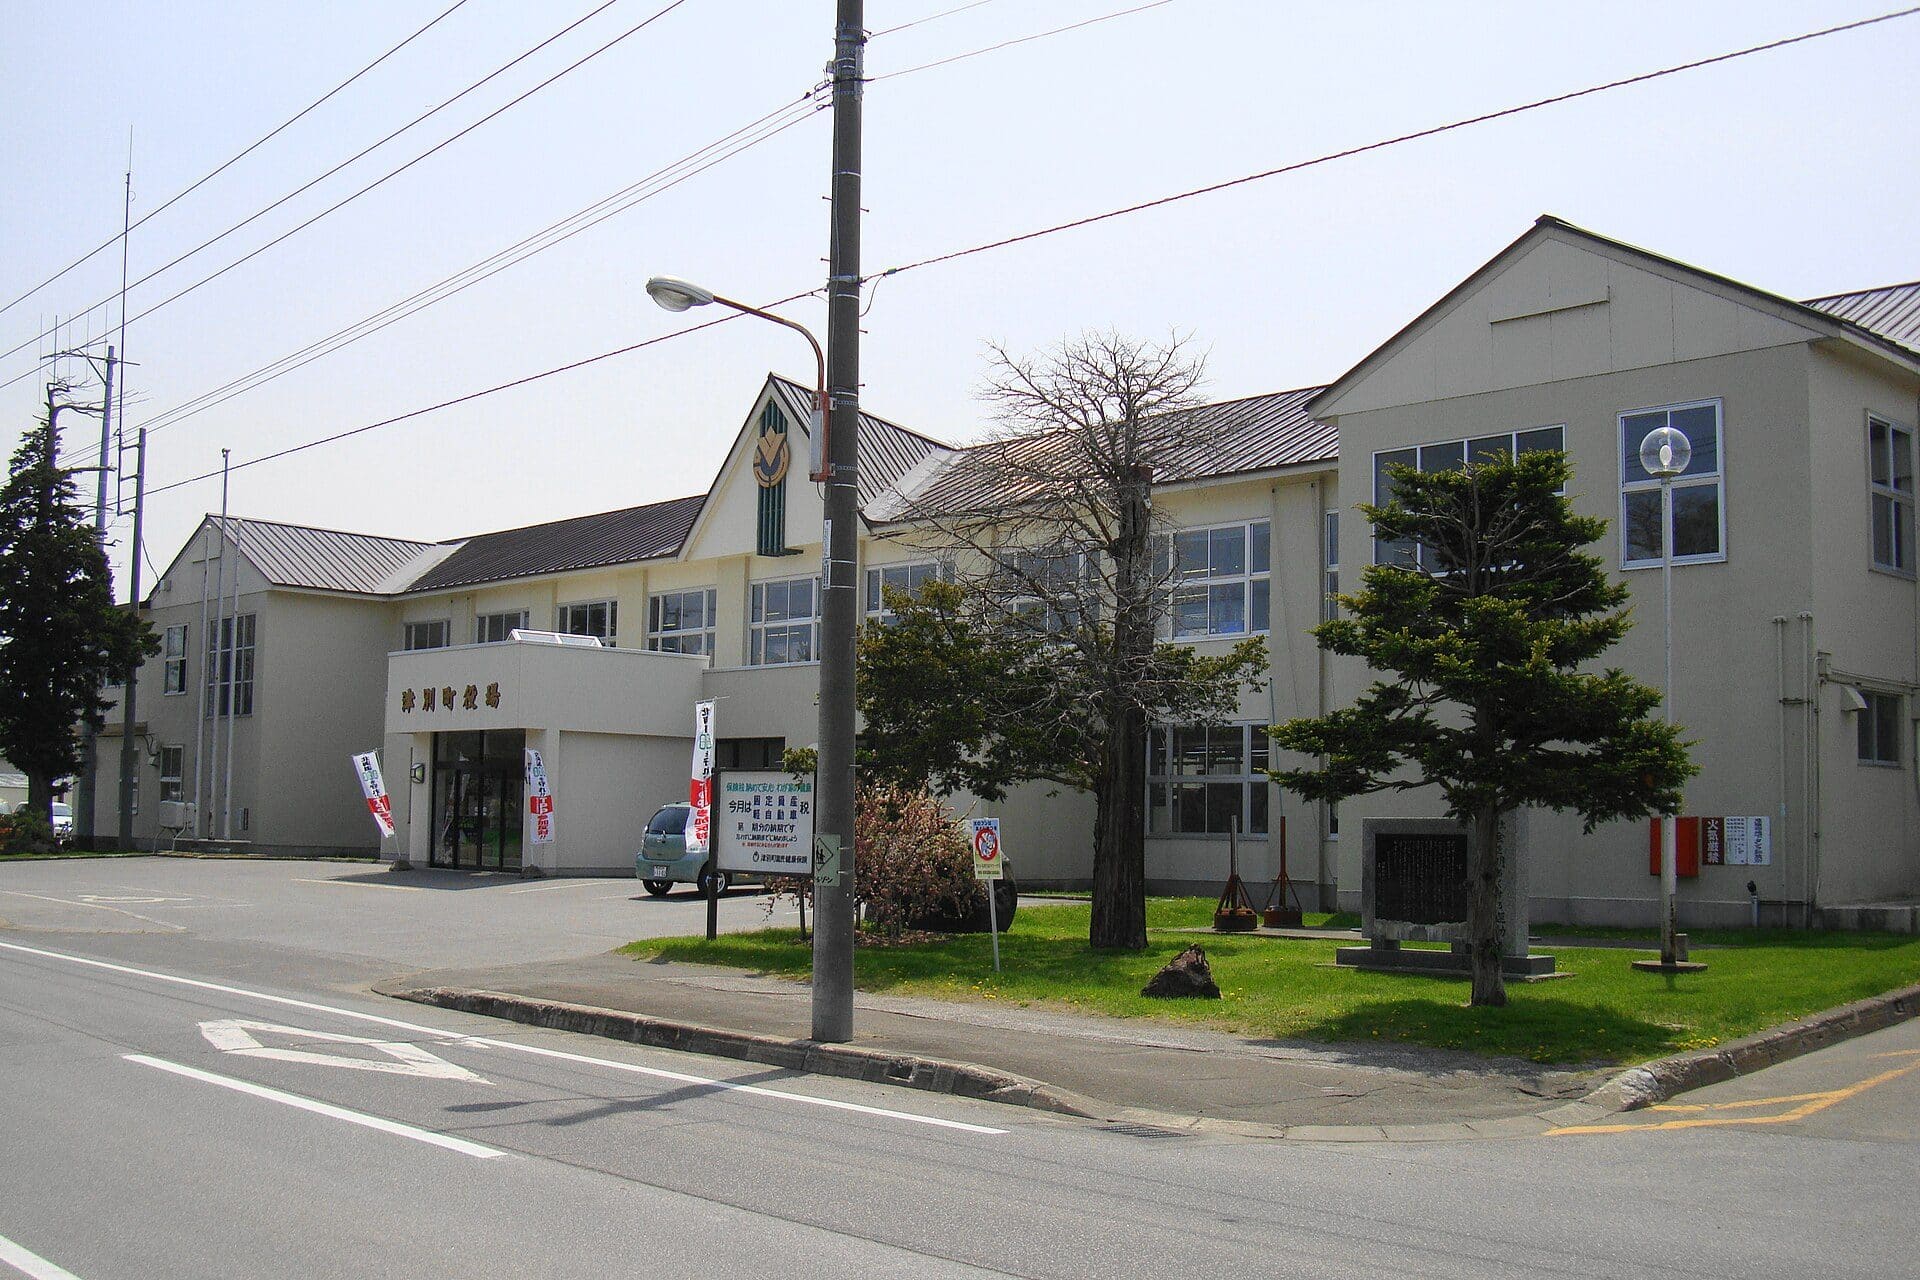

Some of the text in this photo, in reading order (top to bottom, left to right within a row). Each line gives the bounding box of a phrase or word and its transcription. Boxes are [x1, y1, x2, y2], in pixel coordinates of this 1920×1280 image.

[402, 682, 501, 713] 津別町役場
[728, 800, 752, 814] 今月は
[753, 795, 798, 807] 固定資産
[799, 801, 810, 815] 税
[752, 809, 798, 821] 軽自動車
[1707, 819, 1719, 863] 火気厳禁
